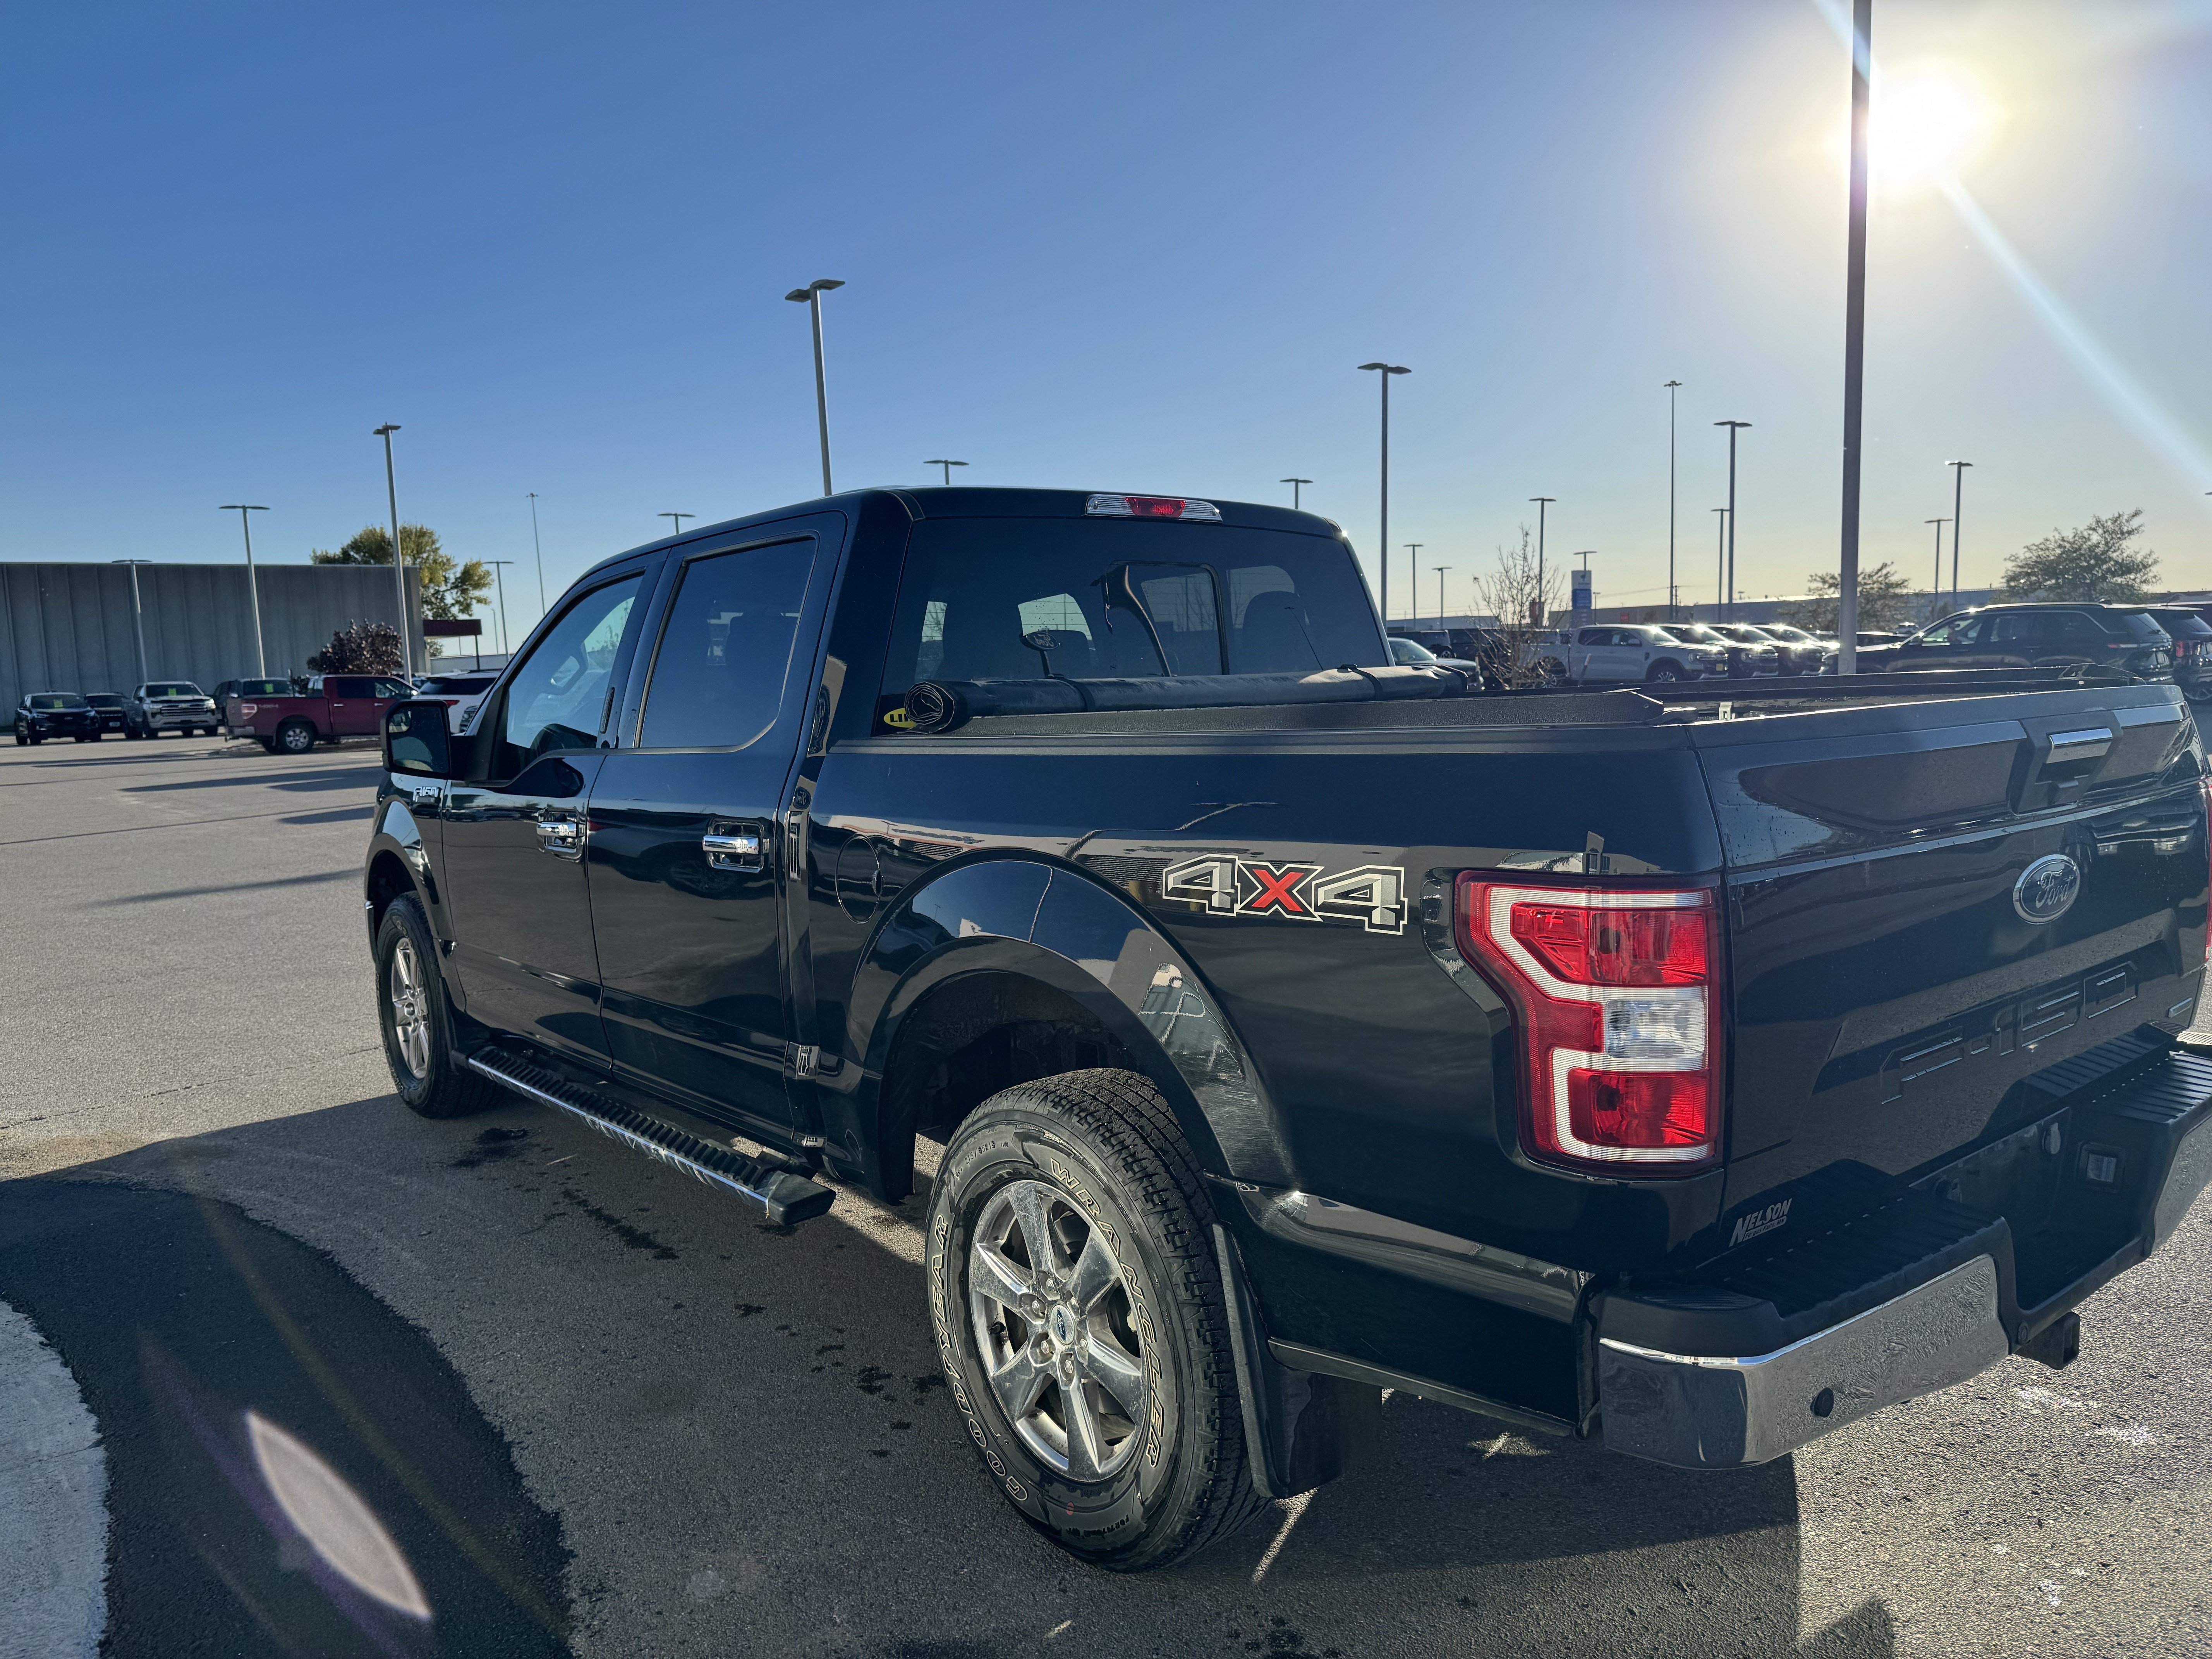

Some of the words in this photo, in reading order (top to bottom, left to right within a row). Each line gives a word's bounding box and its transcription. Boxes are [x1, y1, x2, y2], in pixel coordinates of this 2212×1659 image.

[2035, 869, 2074, 908] Ford
[1728, 1198, 1792, 1247] NELSON
[931, 1214, 1028, 1501] GOODYEAR
[1050, 1157, 1163, 1468] WRANGLER
